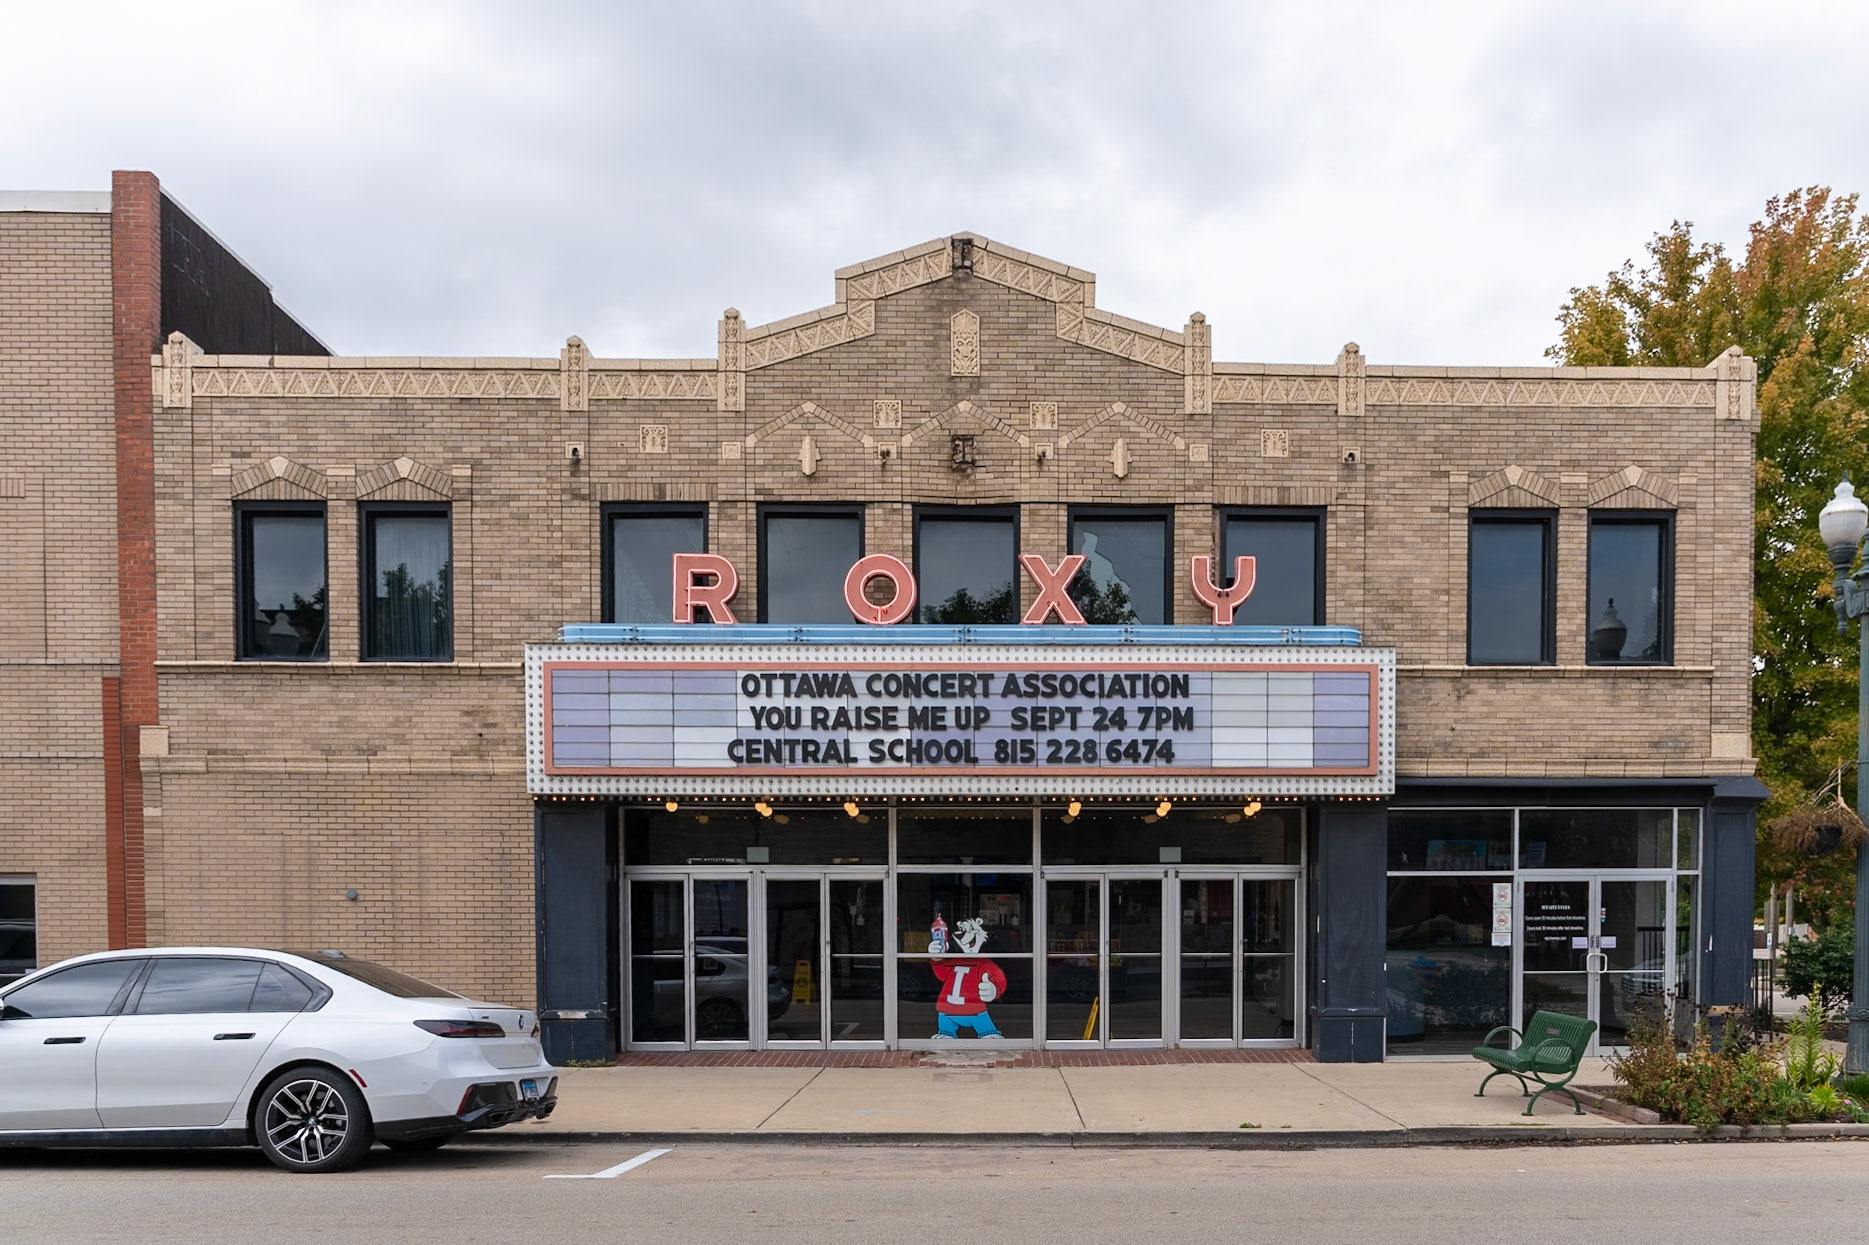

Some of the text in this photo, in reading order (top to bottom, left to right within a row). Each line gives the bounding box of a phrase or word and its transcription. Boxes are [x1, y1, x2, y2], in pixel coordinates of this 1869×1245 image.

[672, 552, 1257, 626] ROXY
[741, 673, 1190, 699] OTTAWA CONCERT ASSOCIATION
[749, 706, 1194, 731] YOU RAISE ME UP SEPT 24 7PM
[727, 738, 1175, 764] CENTRAL SCHOOL 815 228 6474
[946, 966, 971, 1006] I
